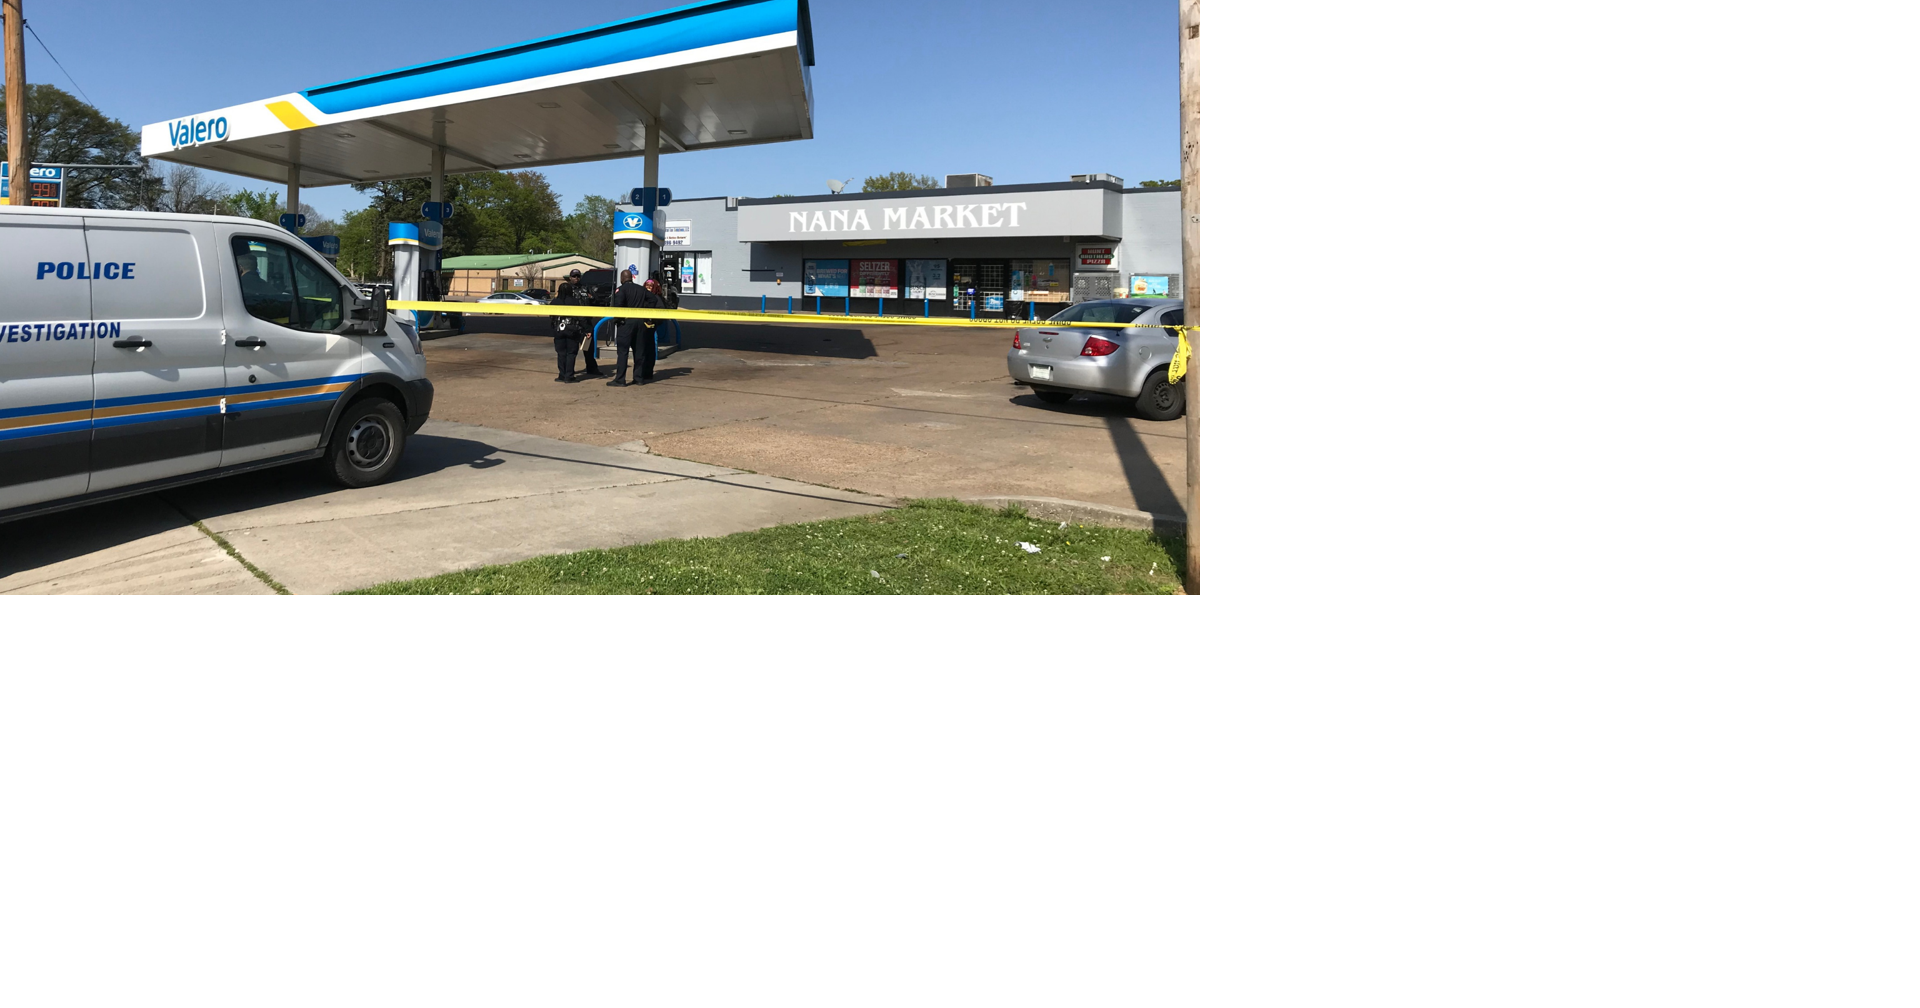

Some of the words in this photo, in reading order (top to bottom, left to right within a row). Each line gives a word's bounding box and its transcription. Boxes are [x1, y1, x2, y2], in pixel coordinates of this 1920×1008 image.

[169, 117, 227, 147] Valero
[29, 167, 56, 177] ero
[789, 209, 872, 233] NANA
[883, 202, 1027, 230] MARKET
[424, 228, 441, 239] Valero
[36, 261, 136, 280] POLICE
[860, 261, 890, 271] SELTZER
